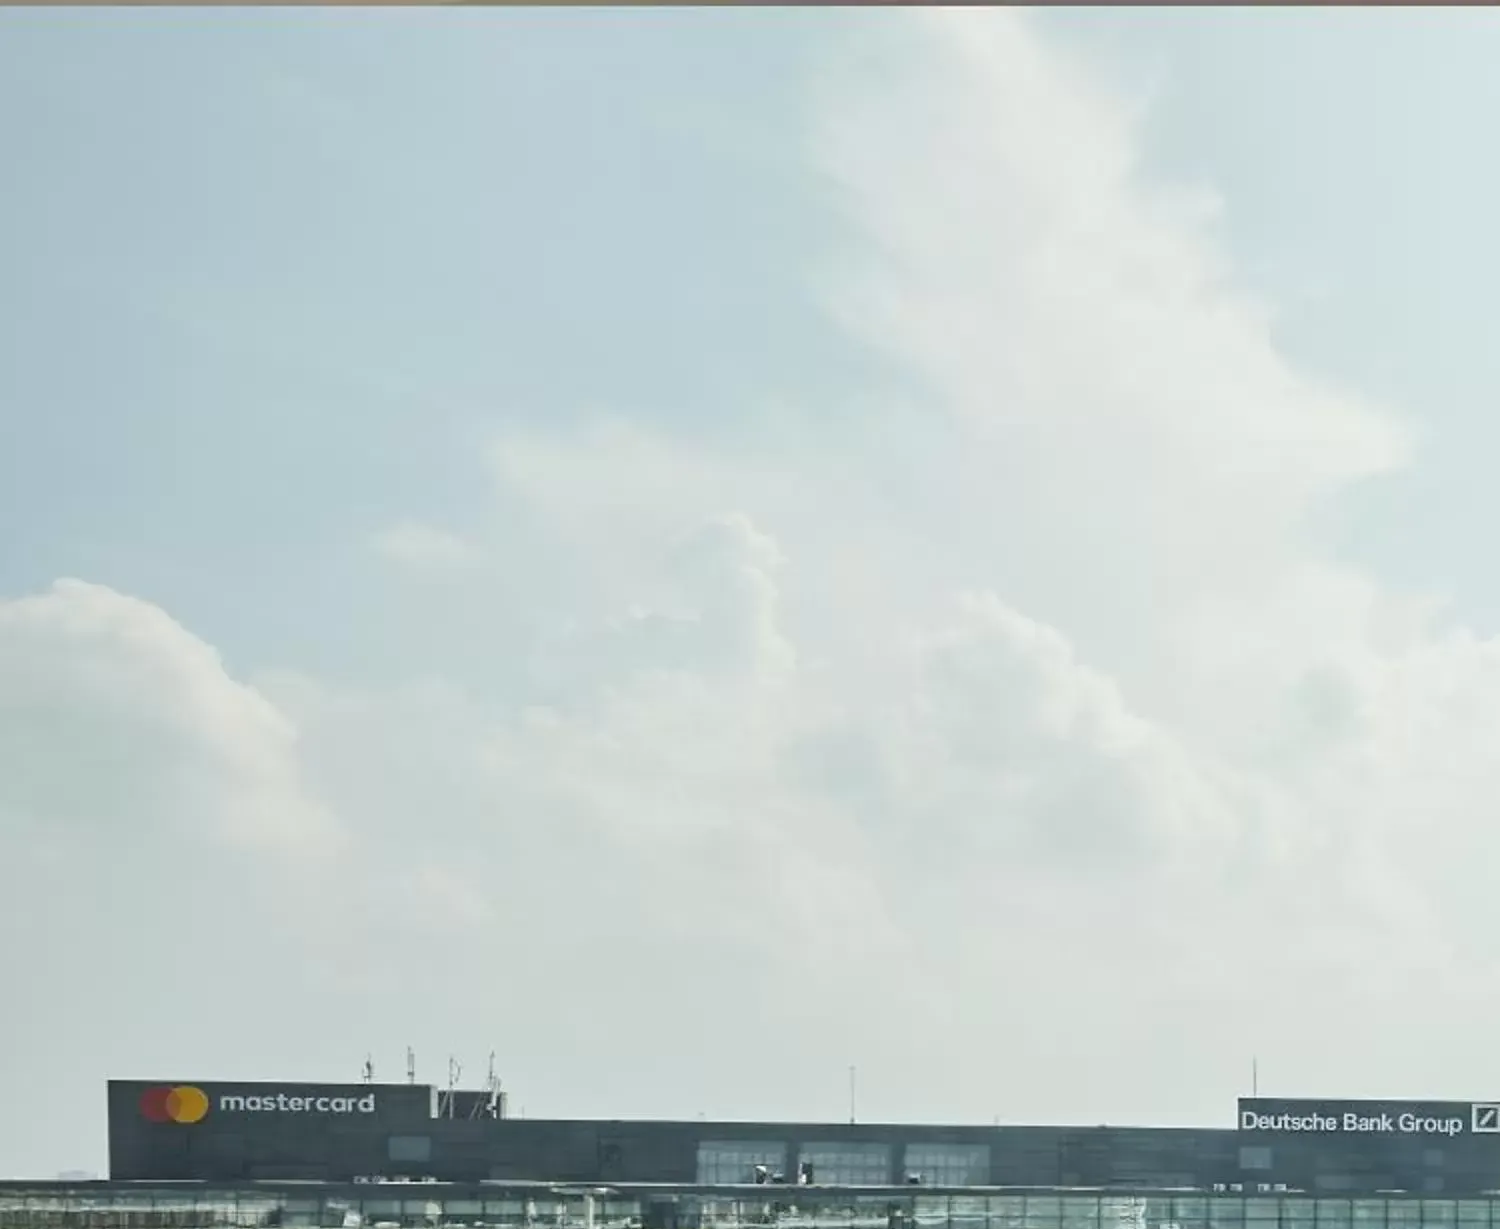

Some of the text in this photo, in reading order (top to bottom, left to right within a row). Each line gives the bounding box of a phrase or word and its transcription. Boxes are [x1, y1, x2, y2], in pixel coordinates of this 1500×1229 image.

[220, 1093, 375, 1112] mastercard
[1241, 1111, 1463, 1136] Deutsche Bank Group
